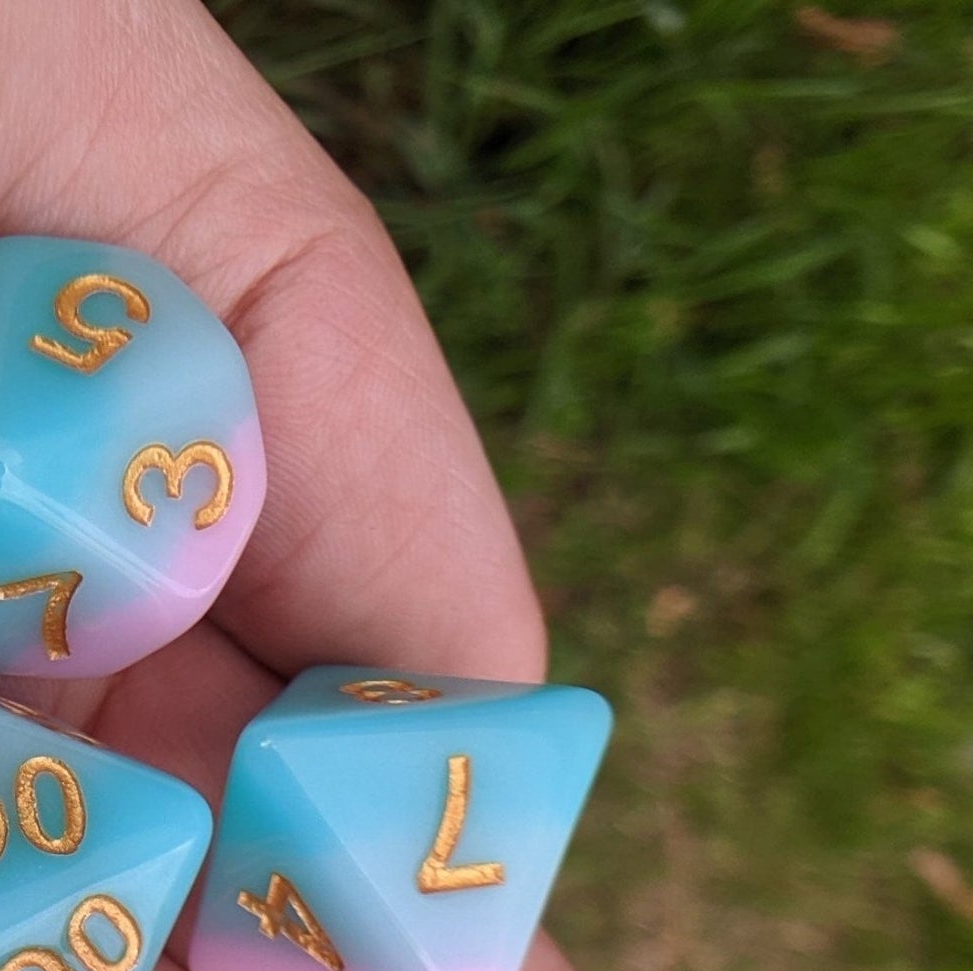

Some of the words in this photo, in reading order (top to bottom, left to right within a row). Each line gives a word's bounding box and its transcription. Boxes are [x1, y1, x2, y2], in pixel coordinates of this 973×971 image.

[29, 273, 152, 374] 5
[122, 438, 235, 531] 3
[417, 754, 506, 893] 7
